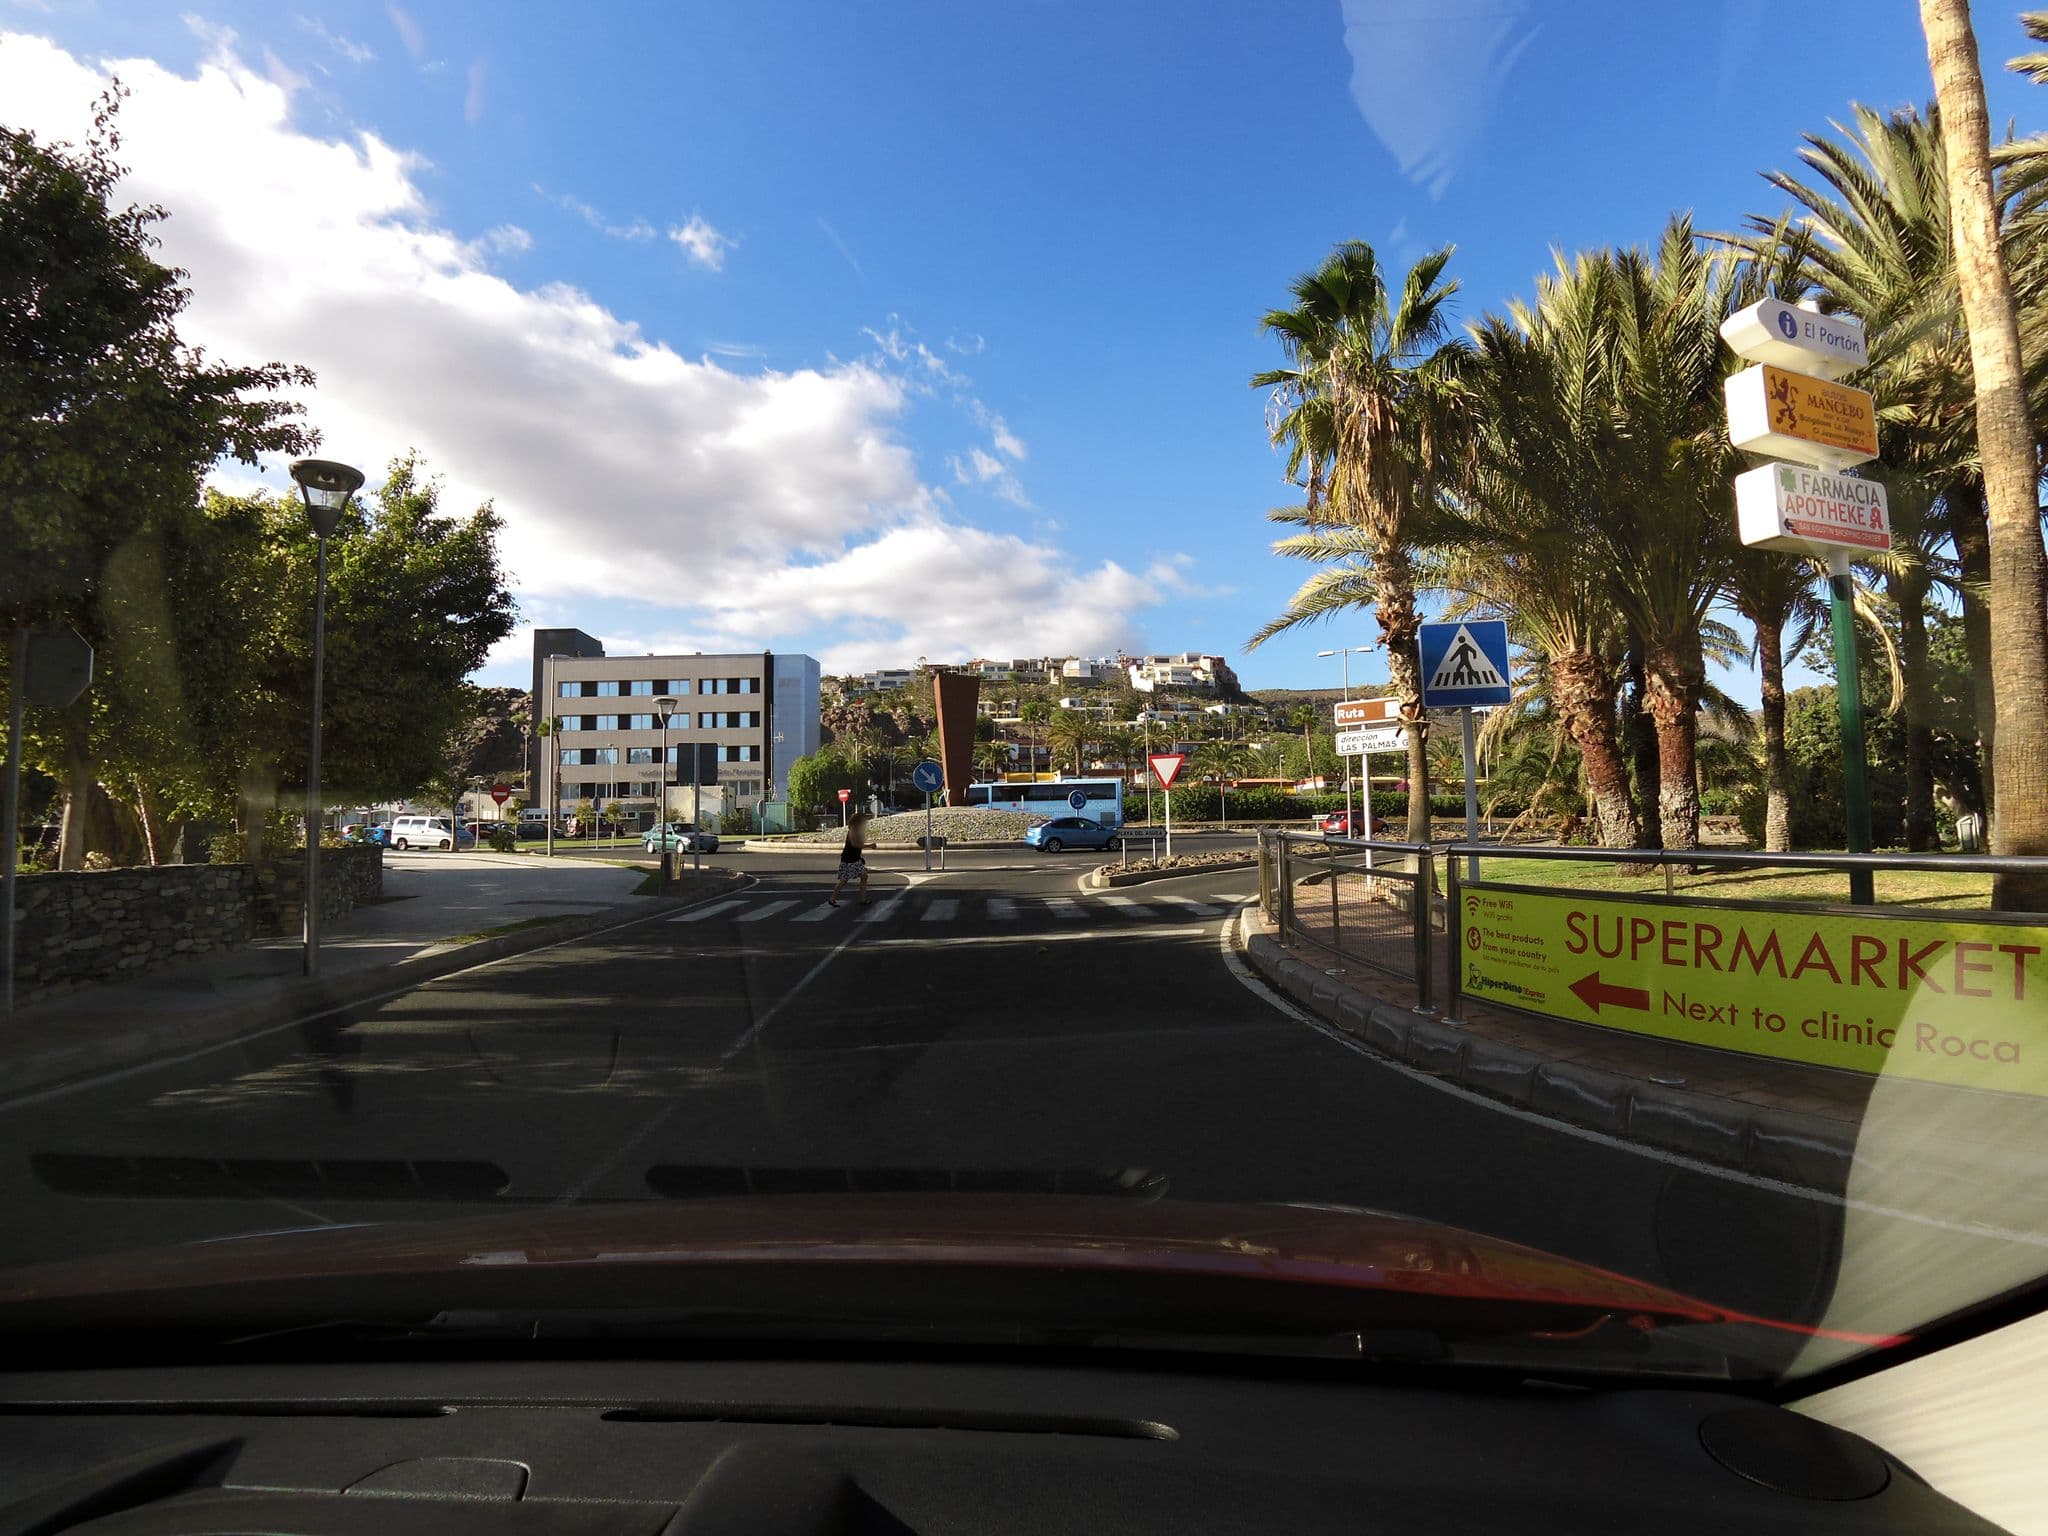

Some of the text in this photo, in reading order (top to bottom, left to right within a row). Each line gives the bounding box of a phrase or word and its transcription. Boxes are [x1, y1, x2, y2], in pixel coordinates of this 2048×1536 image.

[1804, 322, 1860, 353] El Portón
[1807, 394, 1864, 420] MANCEBO
[1801, 473, 1881, 507] FARMACIA
[1785, 494, 1866, 526] APOTHEKE
[1338, 708, 1365, 719] Ruta
[1341, 743, 1358, 752] LAS
[1362, 740, 1397, 750] PALMAS
[1482, 898, 1513, 910] Free Wifi
[1483, 928, 1545, 946] The best products
[1482, 942, 1498, 953] from
[1500, 945, 1517, 955] your
[1517, 946, 1547, 962] country
[1565, 910, 2041, 1001] SUPERMARKET
[1481, 975, 1523, 994] HiperDino
[1663, 989, 2021, 1065] Next to clinic Roca
